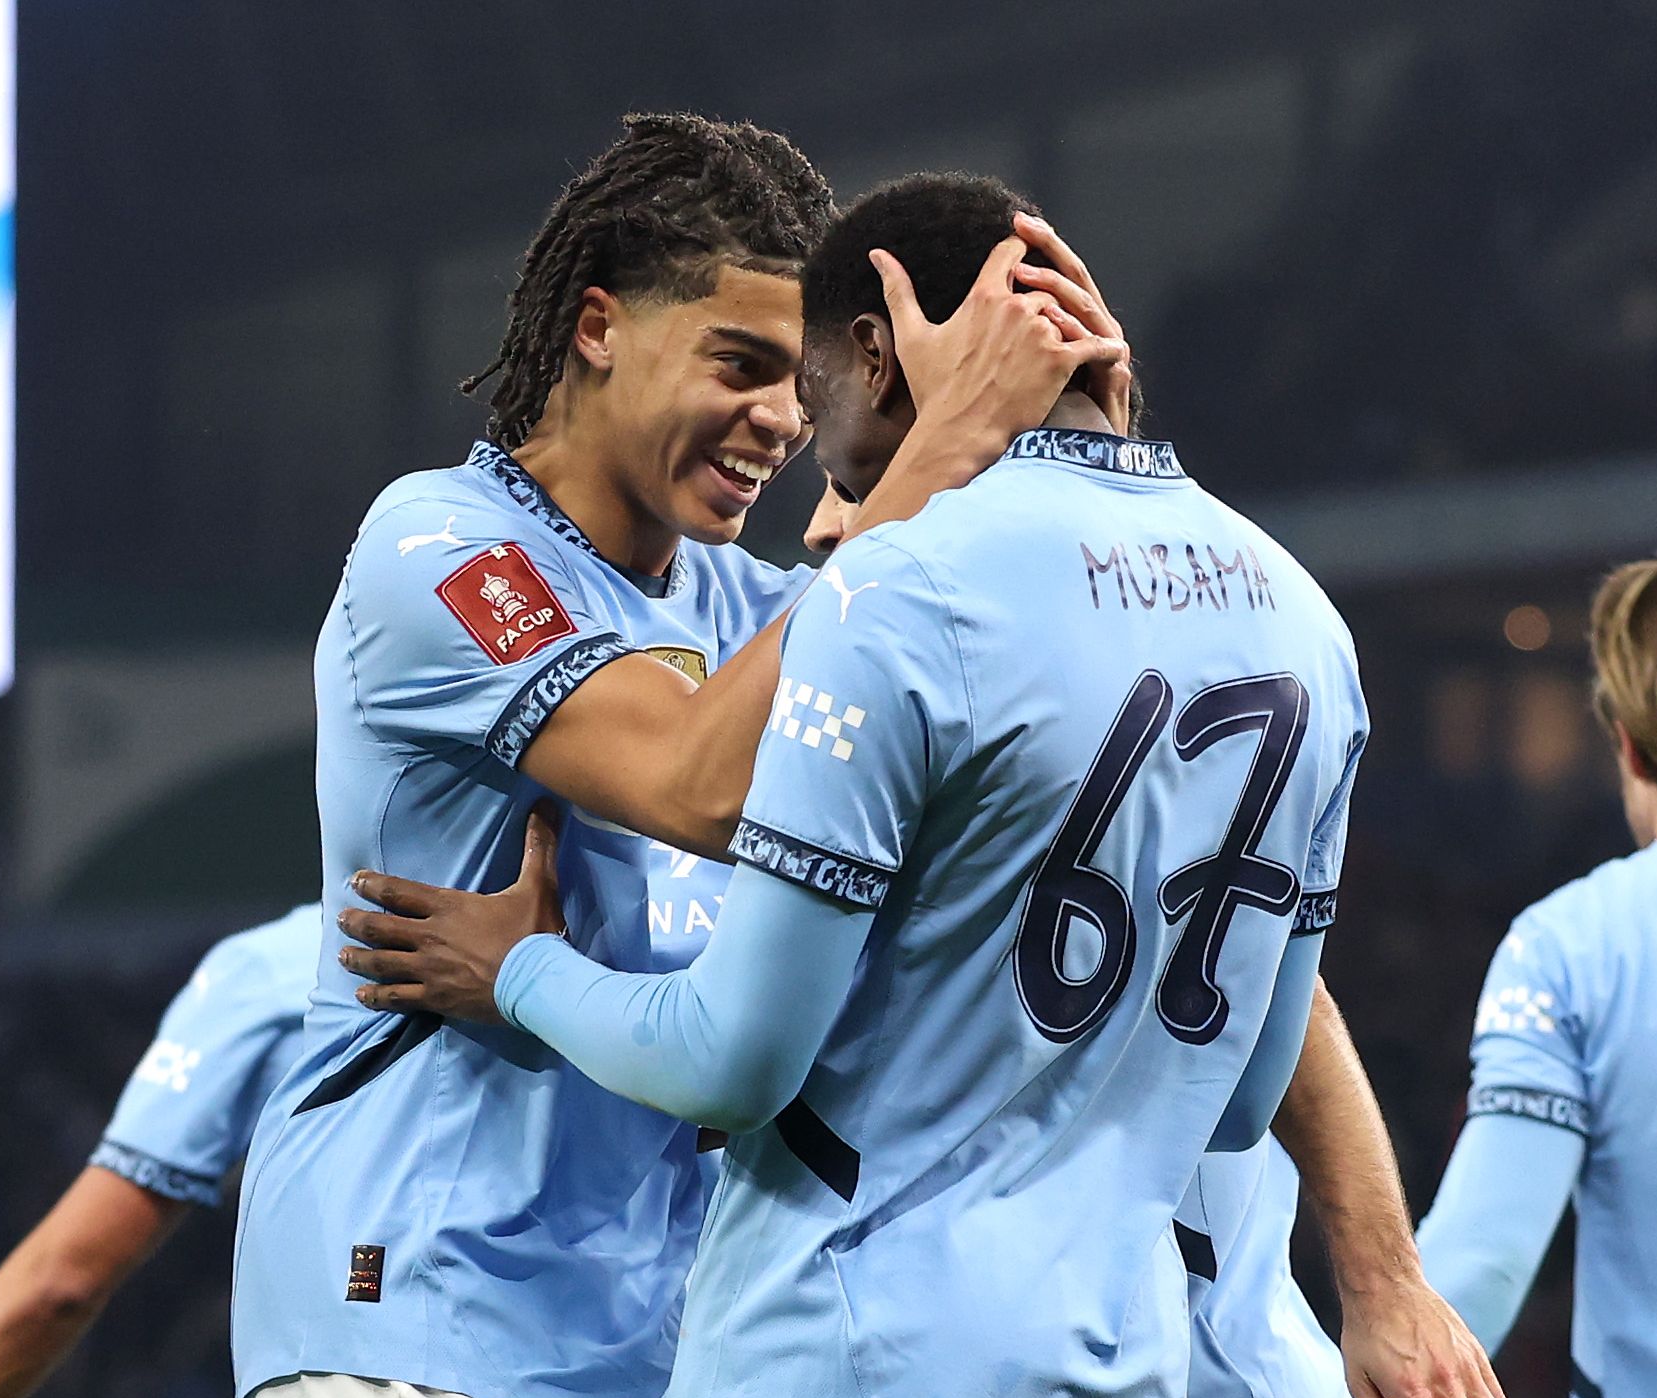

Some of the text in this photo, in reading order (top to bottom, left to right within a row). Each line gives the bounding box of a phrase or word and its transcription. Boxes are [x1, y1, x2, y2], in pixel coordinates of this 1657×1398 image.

[1079, 541, 1276, 611] MUBAMA
[496, 607, 555, 653] FA CUP
[1013, 669, 1310, 1046] 67
